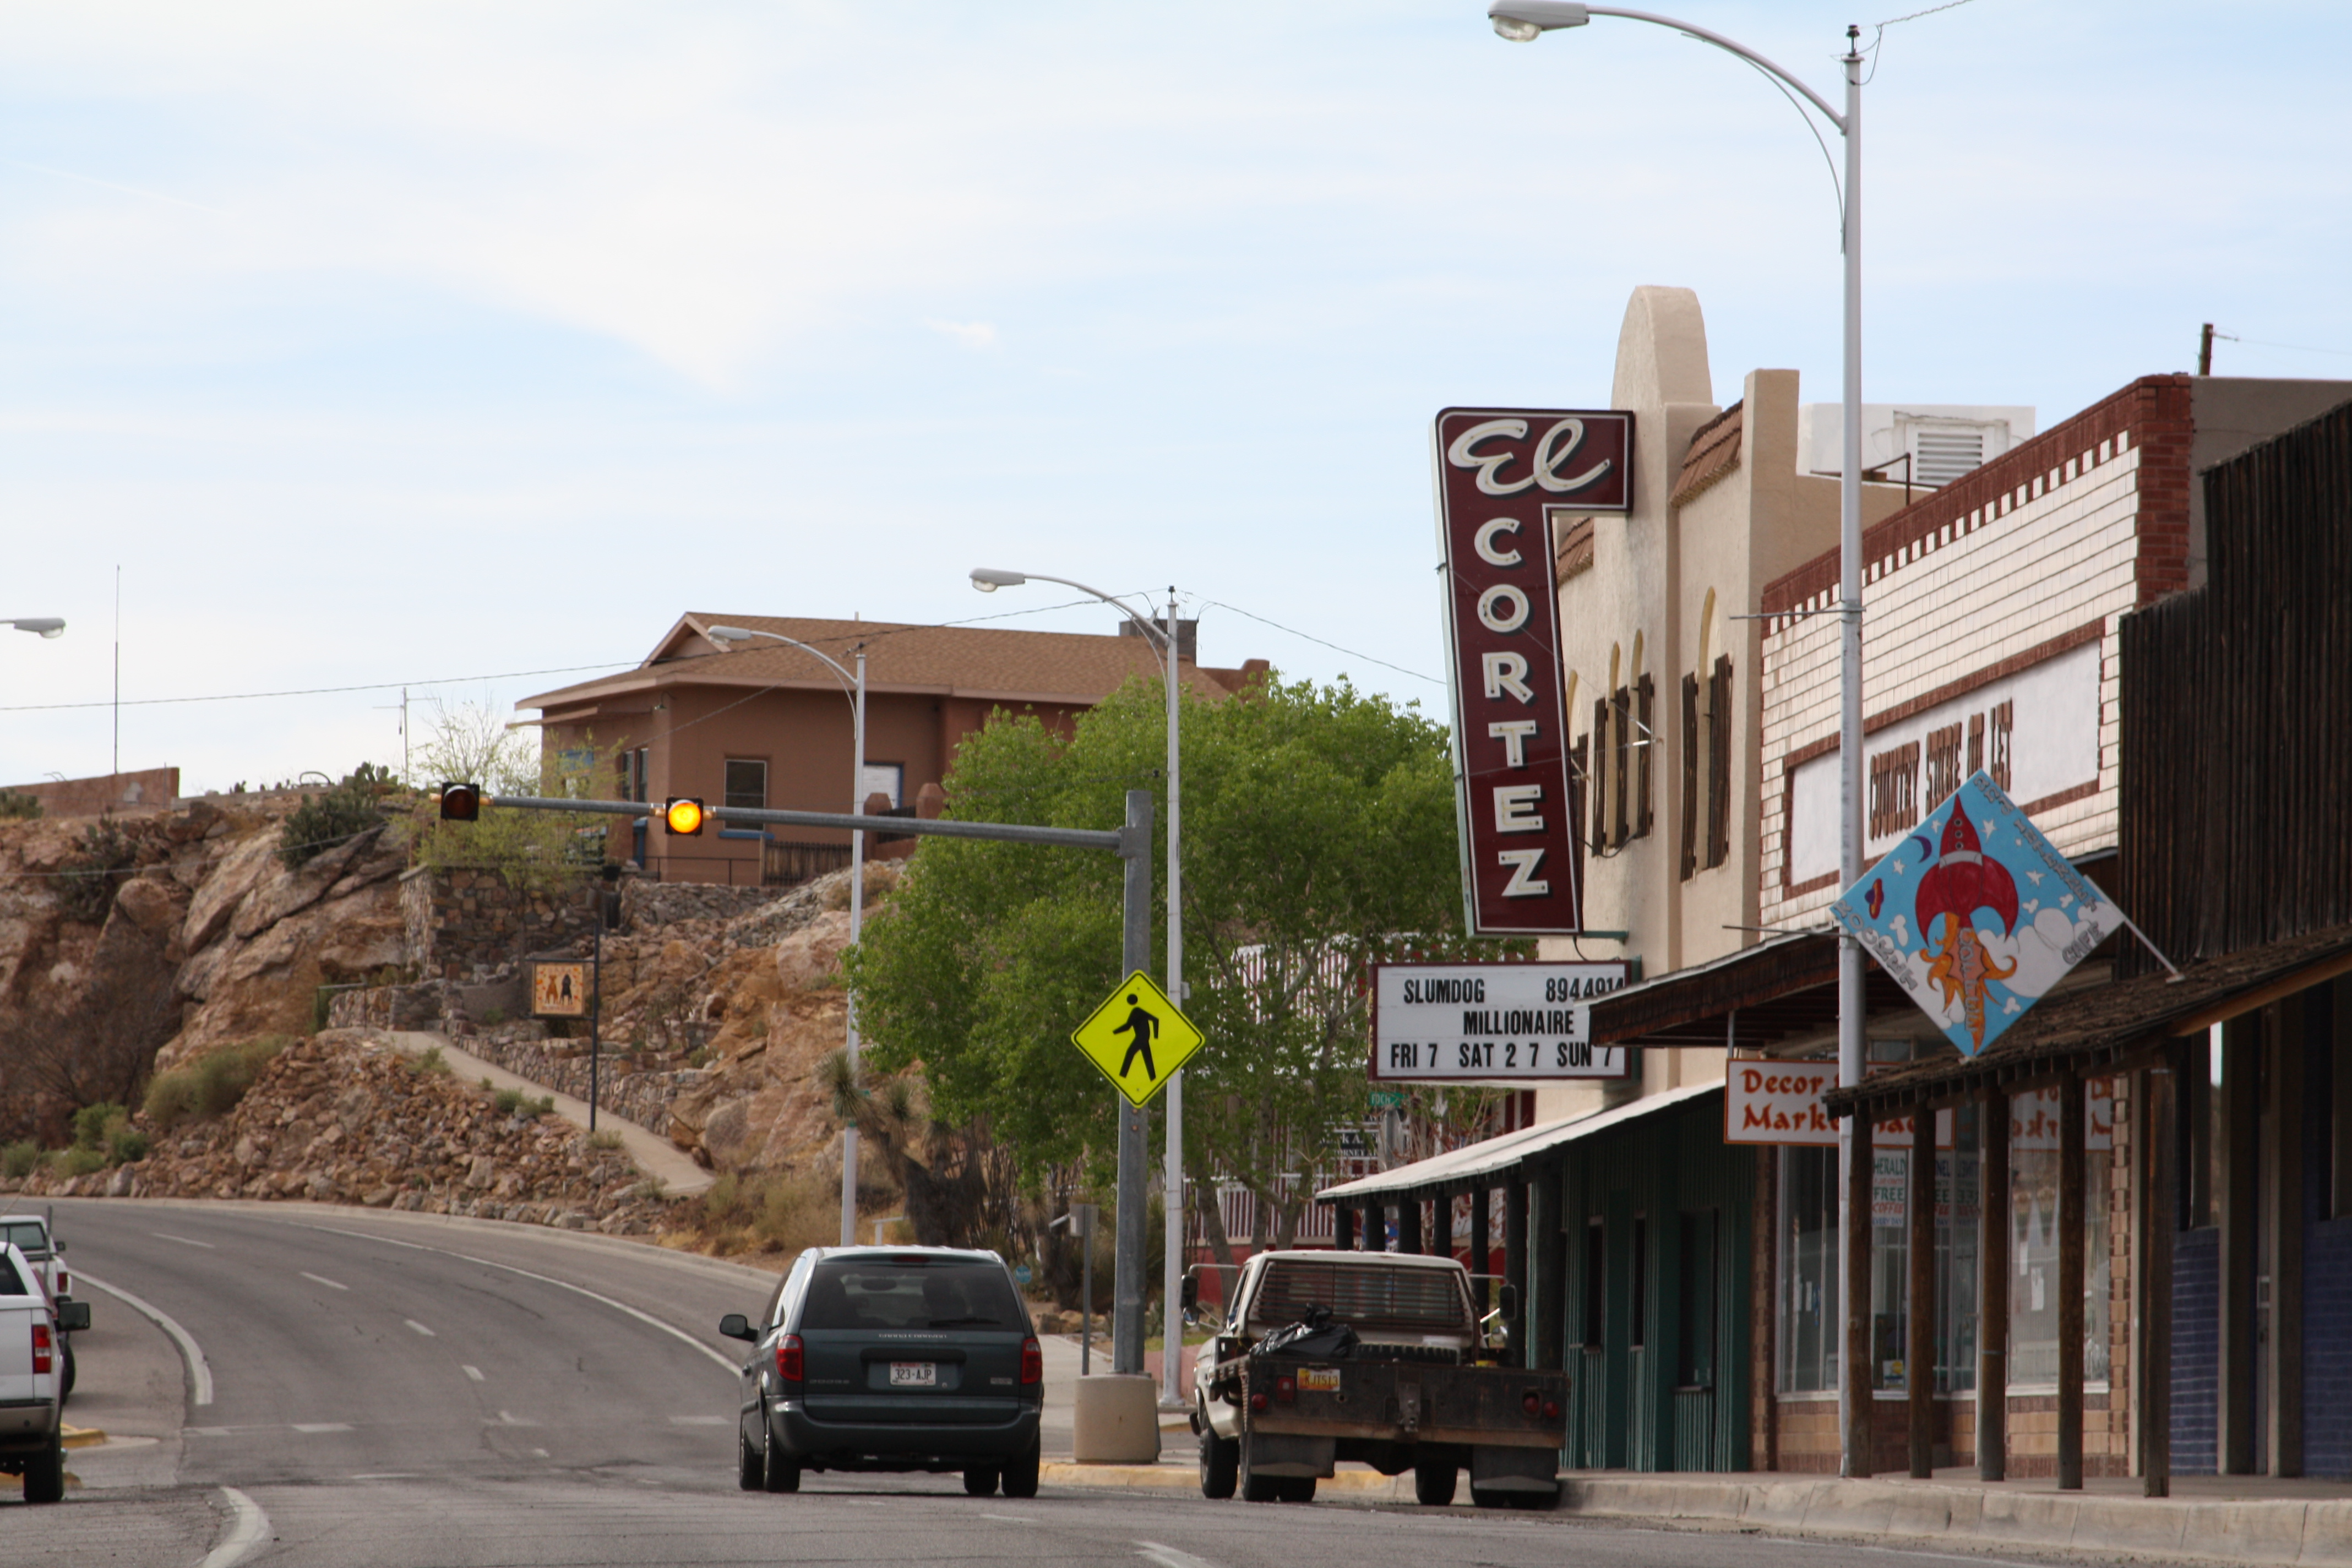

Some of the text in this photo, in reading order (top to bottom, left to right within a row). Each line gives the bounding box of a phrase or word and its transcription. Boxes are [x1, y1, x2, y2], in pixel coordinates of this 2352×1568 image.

[1448, 418, 1610, 495] El
[1474, 518, 1548, 897] CORTEZ
[2013, 818, 2097, 911] INTERNET
[1834, 900, 1918, 990] ROCKET
[2062, 921, 2104, 965] CAFE
[1404, 978, 1484, 1004] SLUMDOG
[1463, 1010, 1574, 1035] MILLIONAIRE
[1391, 1044, 1417, 1068] FRI
[1428, 1043, 1438, 1067] 7
[1459, 1043, 1494, 1068] SAT
[1505, 1043, 1516, 1067] 2
[1529, 1043, 1539, 1067] 7
[1557, 1042, 1592, 1067] SUN
[1740, 1069, 1825, 1096] Decor
[1874, 1157, 1905, 1175] HERALD
[1874, 1186, 1904, 1201] FREE
[1872, 1202, 1904, 1215] COFFEE
